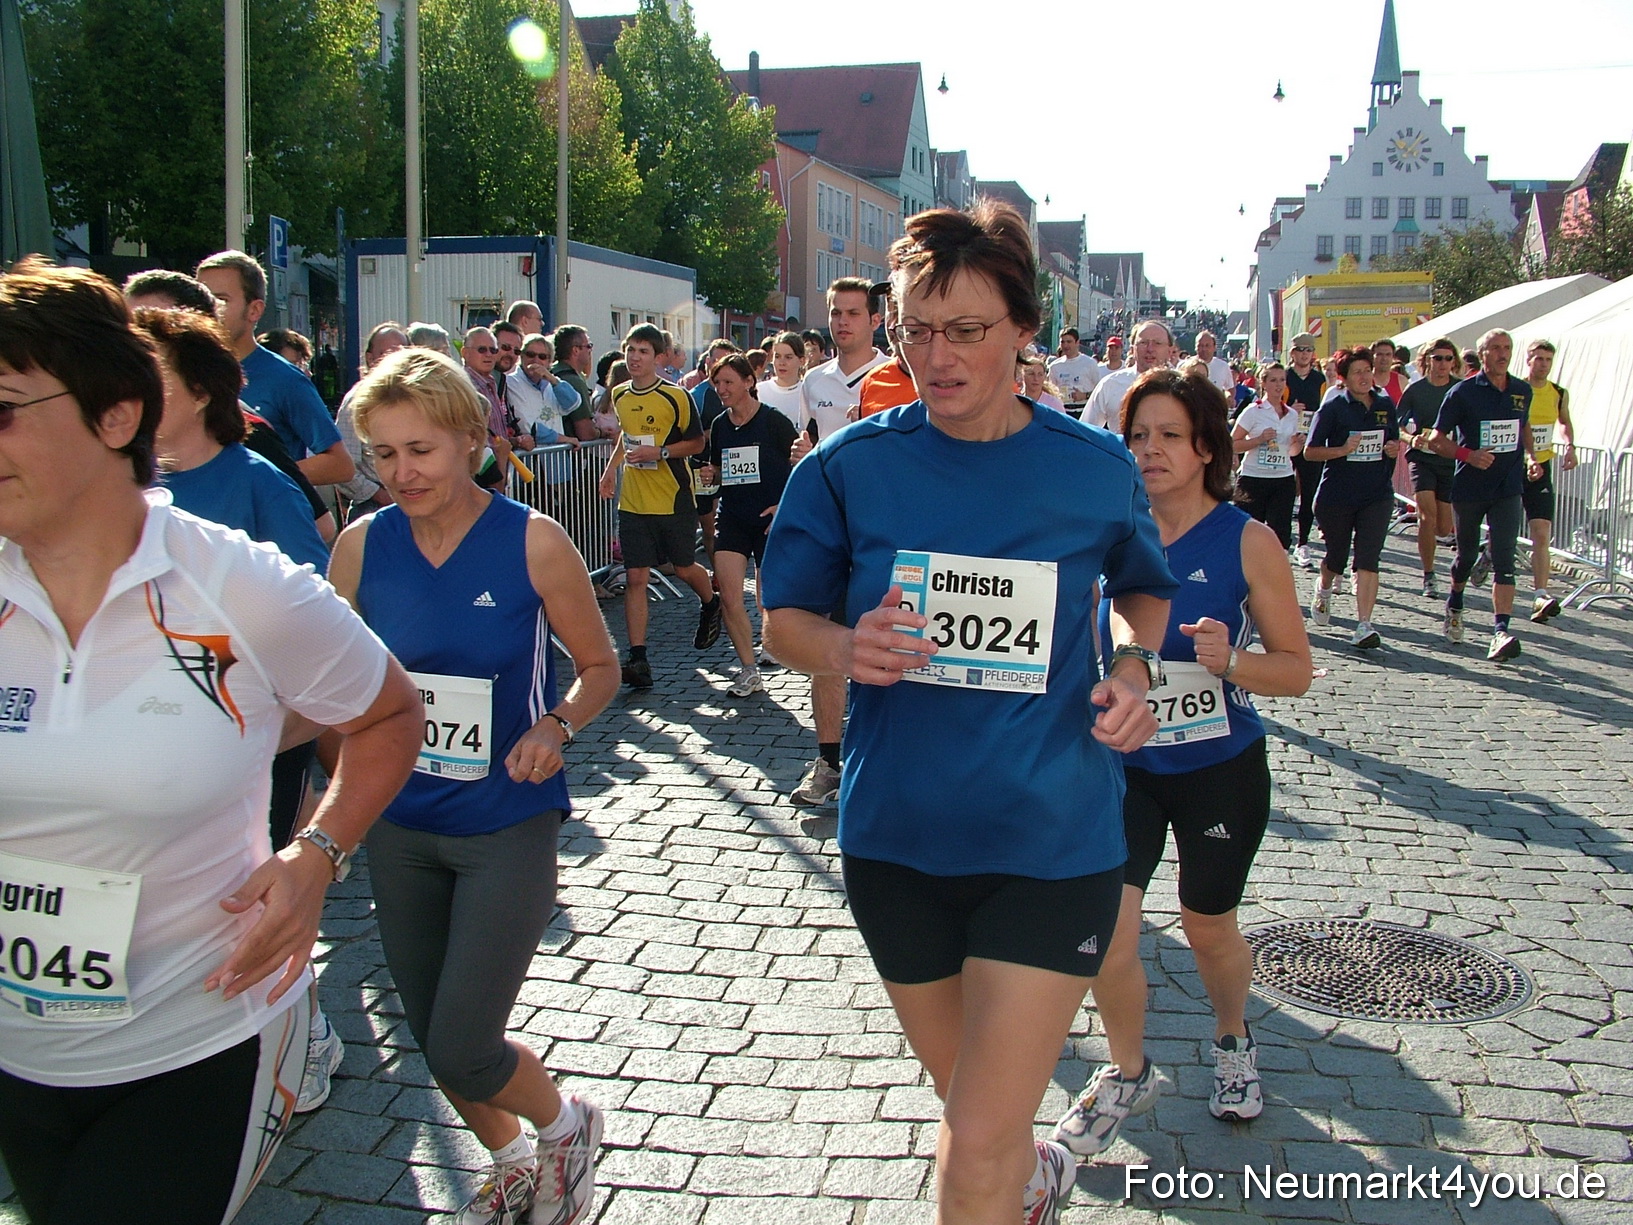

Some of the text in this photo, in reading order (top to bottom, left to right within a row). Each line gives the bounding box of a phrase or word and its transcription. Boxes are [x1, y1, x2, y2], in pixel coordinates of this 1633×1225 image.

[273, 223, 284, 260] P
[817, 400, 833, 408] FILA
[1490, 423, 1512, 431] Norbert
[1491, 433, 1517, 444] 3173
[1358, 442, 1382, 453] 3175
[1266, 454, 1286, 464] 2971
[730, 462, 757, 475] 3423
[931, 569, 1014, 598] christa
[930, 611, 1040, 656] 3024
[984, 669, 1045, 685] PFLEIDERER
[1146, 689, 1216, 723] 2769
[1185, 722, 1228, 736] PFLEIDERER
[46, 1001, 128, 1013] PFLEIDERER
